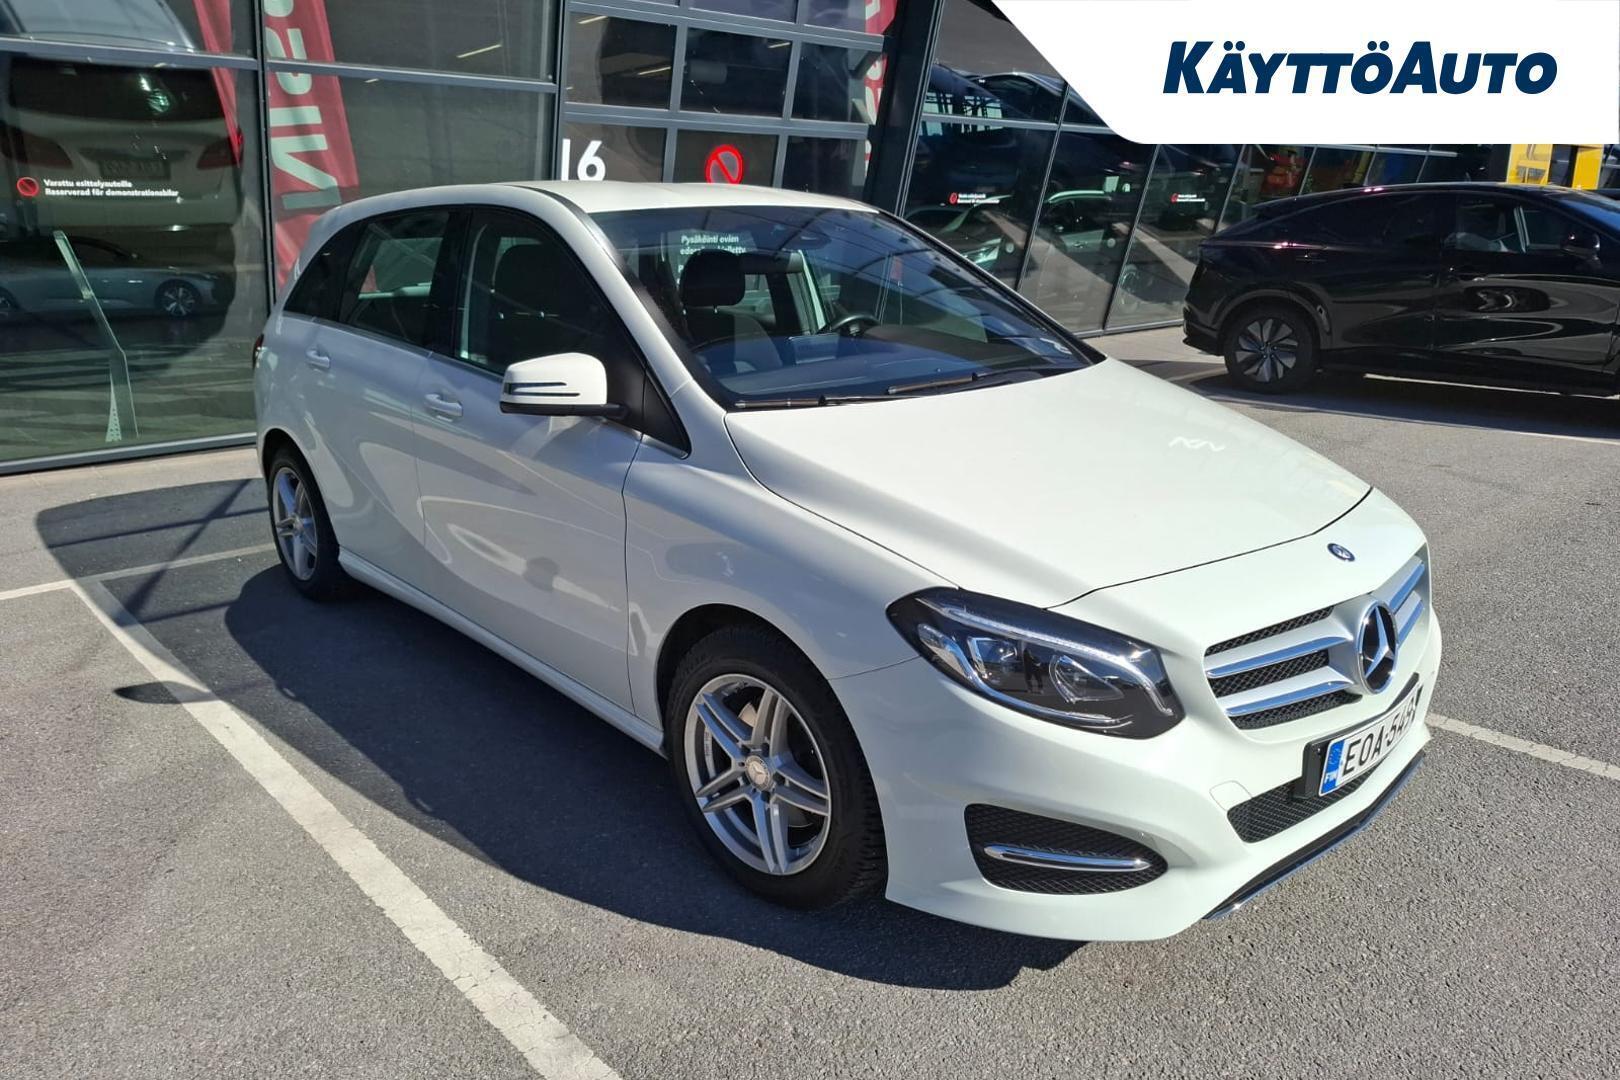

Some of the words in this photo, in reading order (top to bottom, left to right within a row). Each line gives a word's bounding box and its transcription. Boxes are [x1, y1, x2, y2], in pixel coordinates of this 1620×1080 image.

[561, 139, 605, 181] 16
[43, 178, 75, 187] Varattu
[45, 188, 91, 196] Reserverad
[92, 188, 104, 196] för
